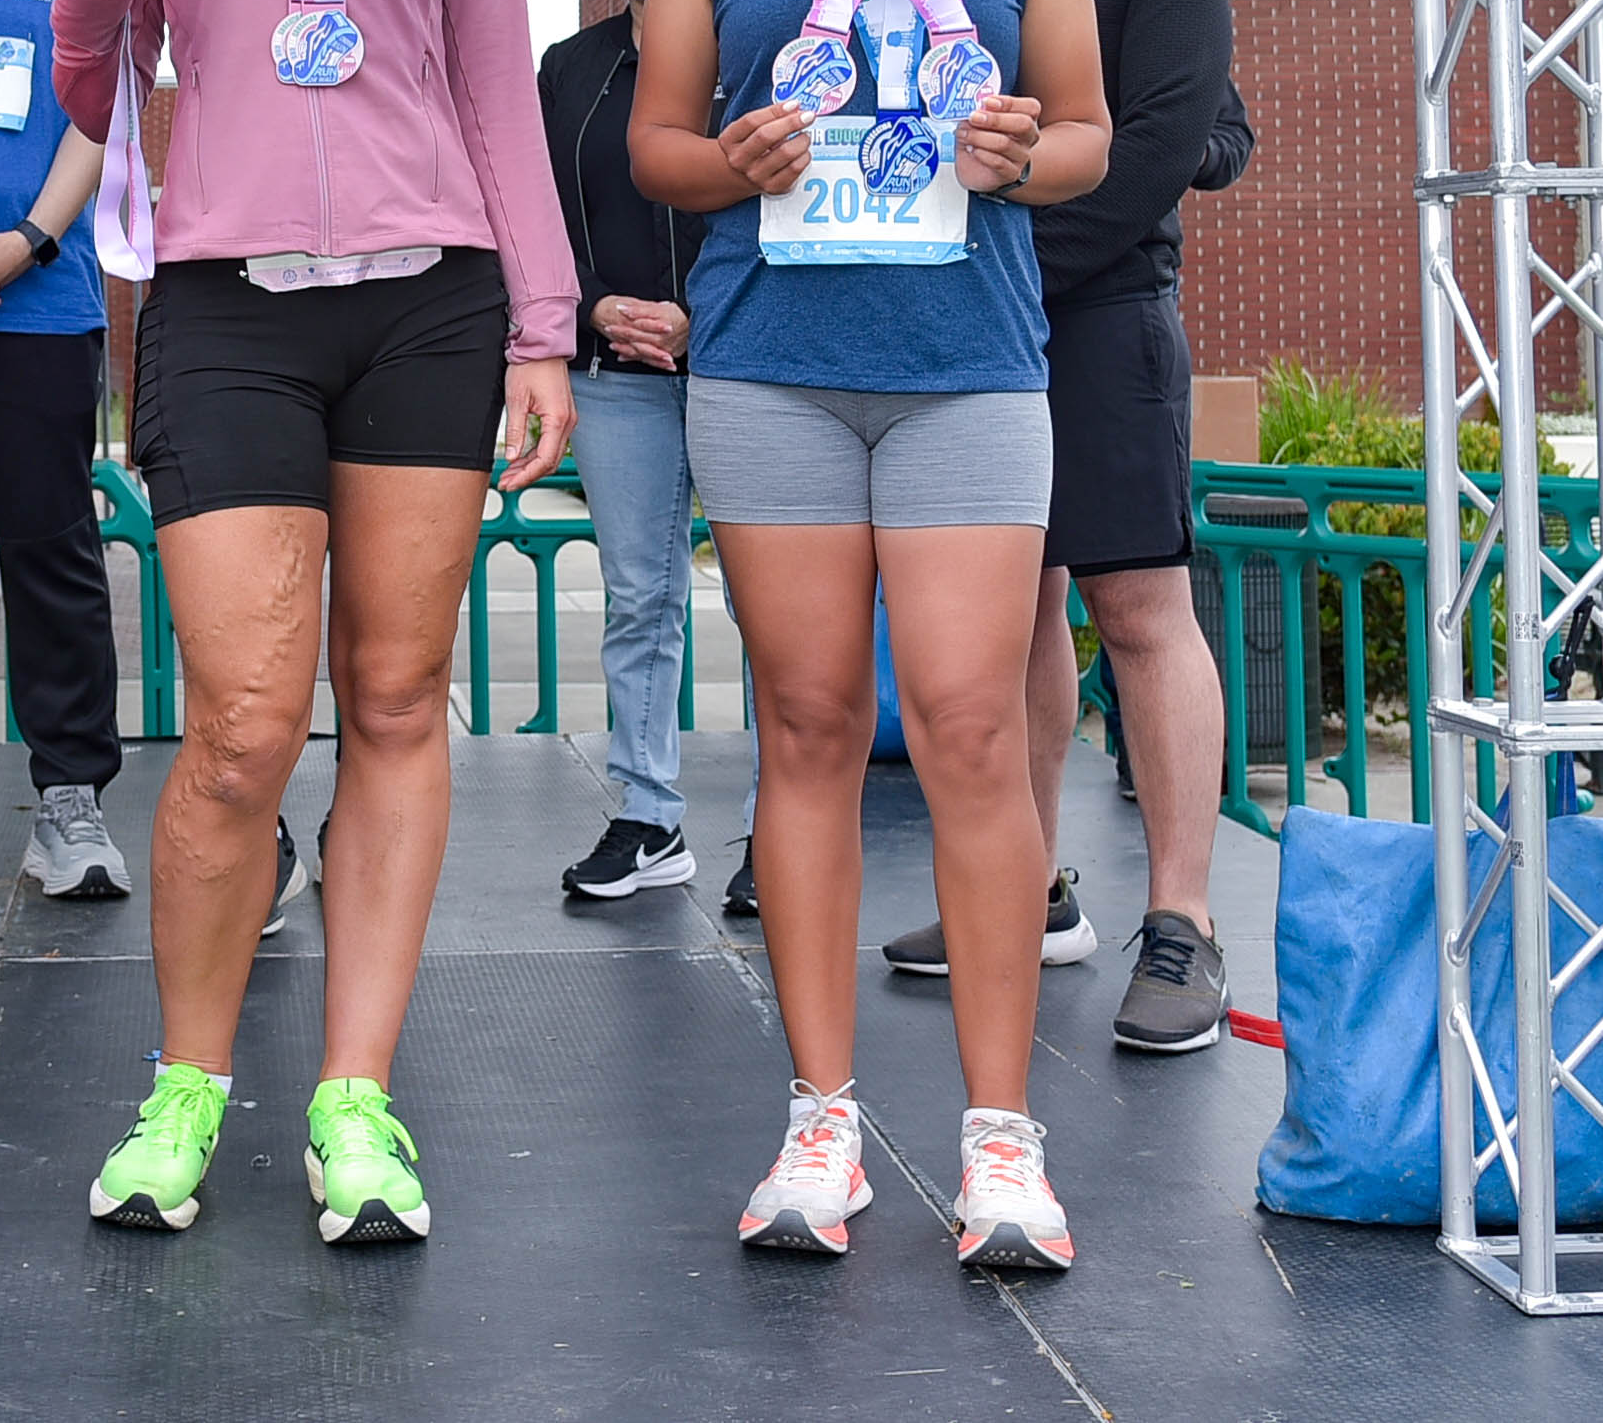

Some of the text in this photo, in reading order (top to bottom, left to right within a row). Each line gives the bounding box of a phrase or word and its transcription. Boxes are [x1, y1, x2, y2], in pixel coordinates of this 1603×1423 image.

[950, 99, 975, 111] RUN
[887, 177, 910, 188] RUN
[803, 178, 919, 224] 2042
